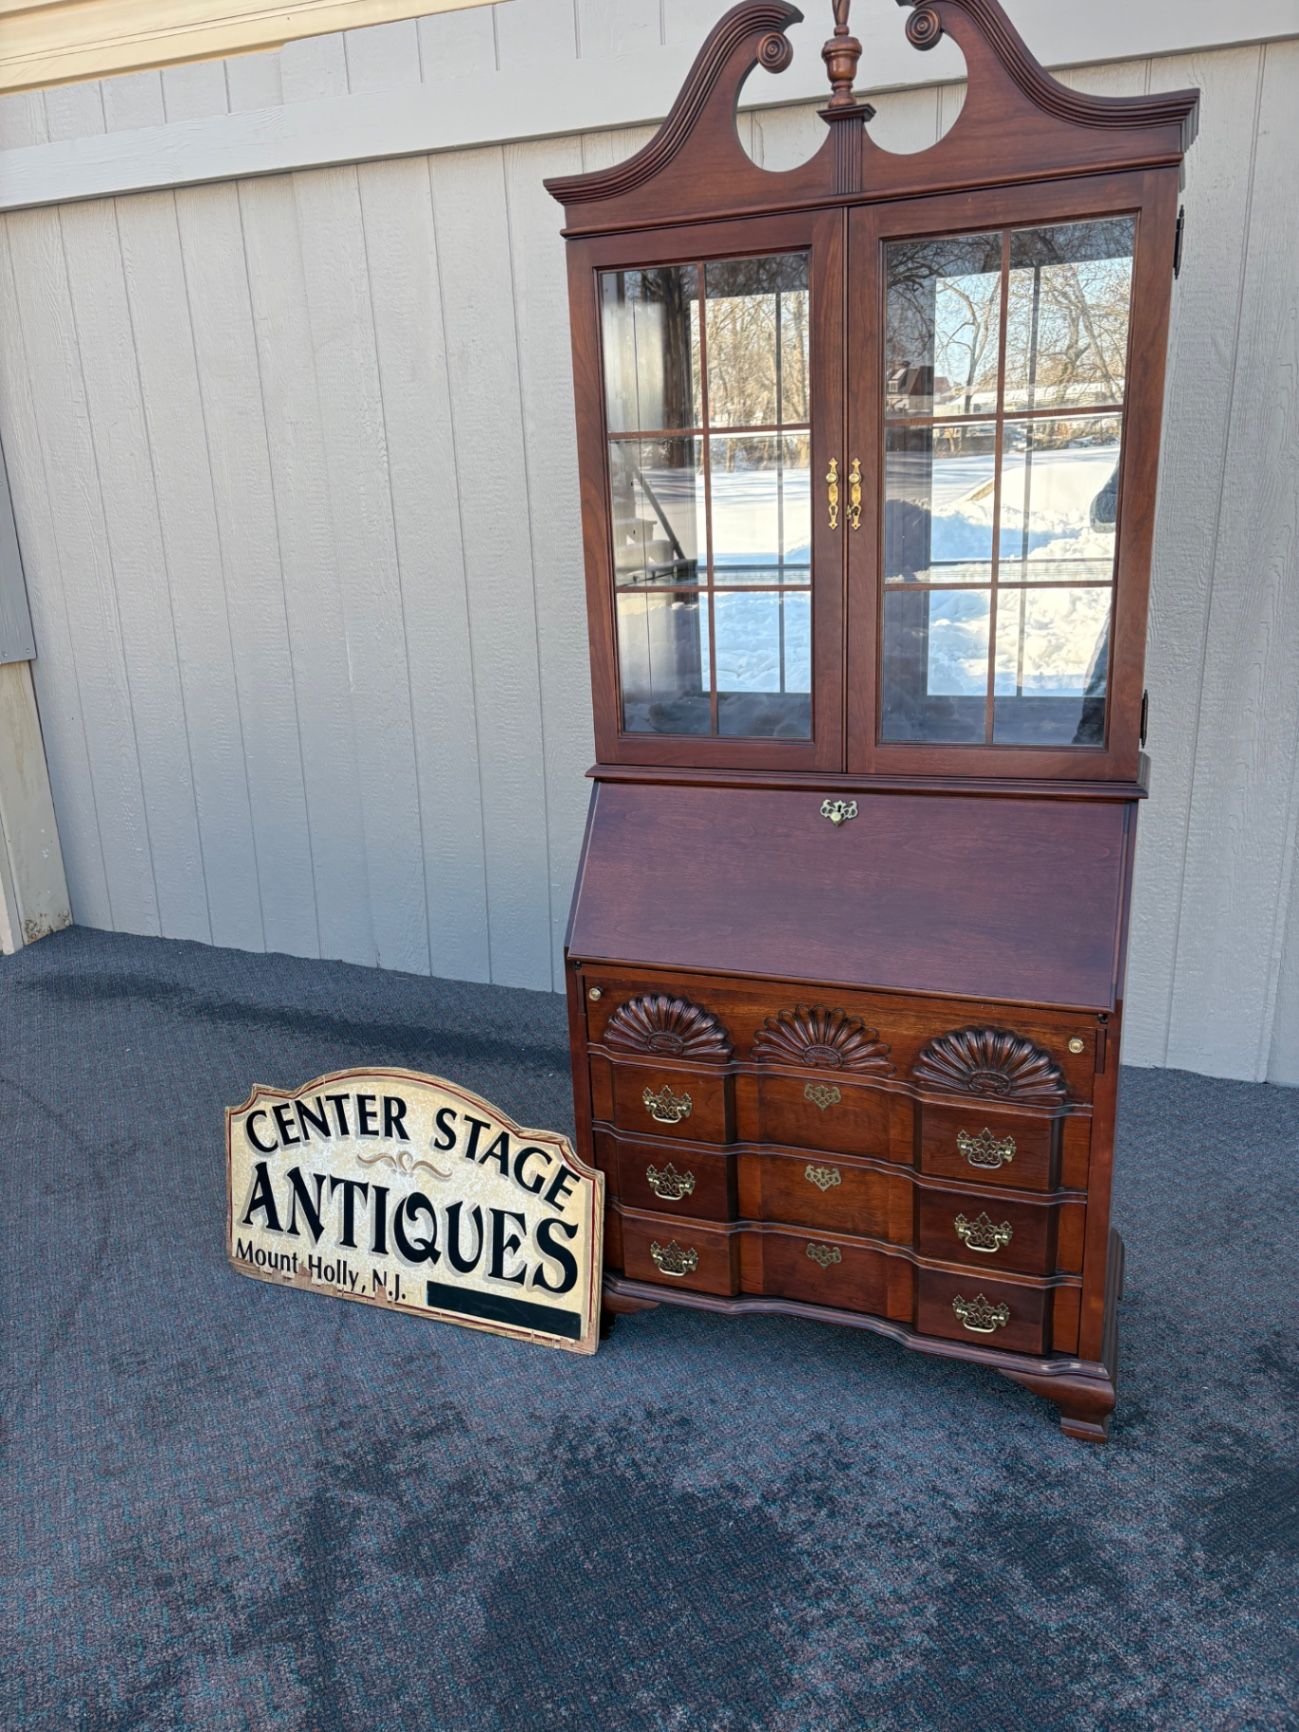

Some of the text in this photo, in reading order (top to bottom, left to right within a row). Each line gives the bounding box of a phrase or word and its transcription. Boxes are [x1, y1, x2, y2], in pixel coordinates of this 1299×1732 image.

[245, 1094, 581, 1212] CENTER STAGE
[235, 1238, 298, 1275] Mount
[242, 1161, 579, 1294] ANTIQUES
